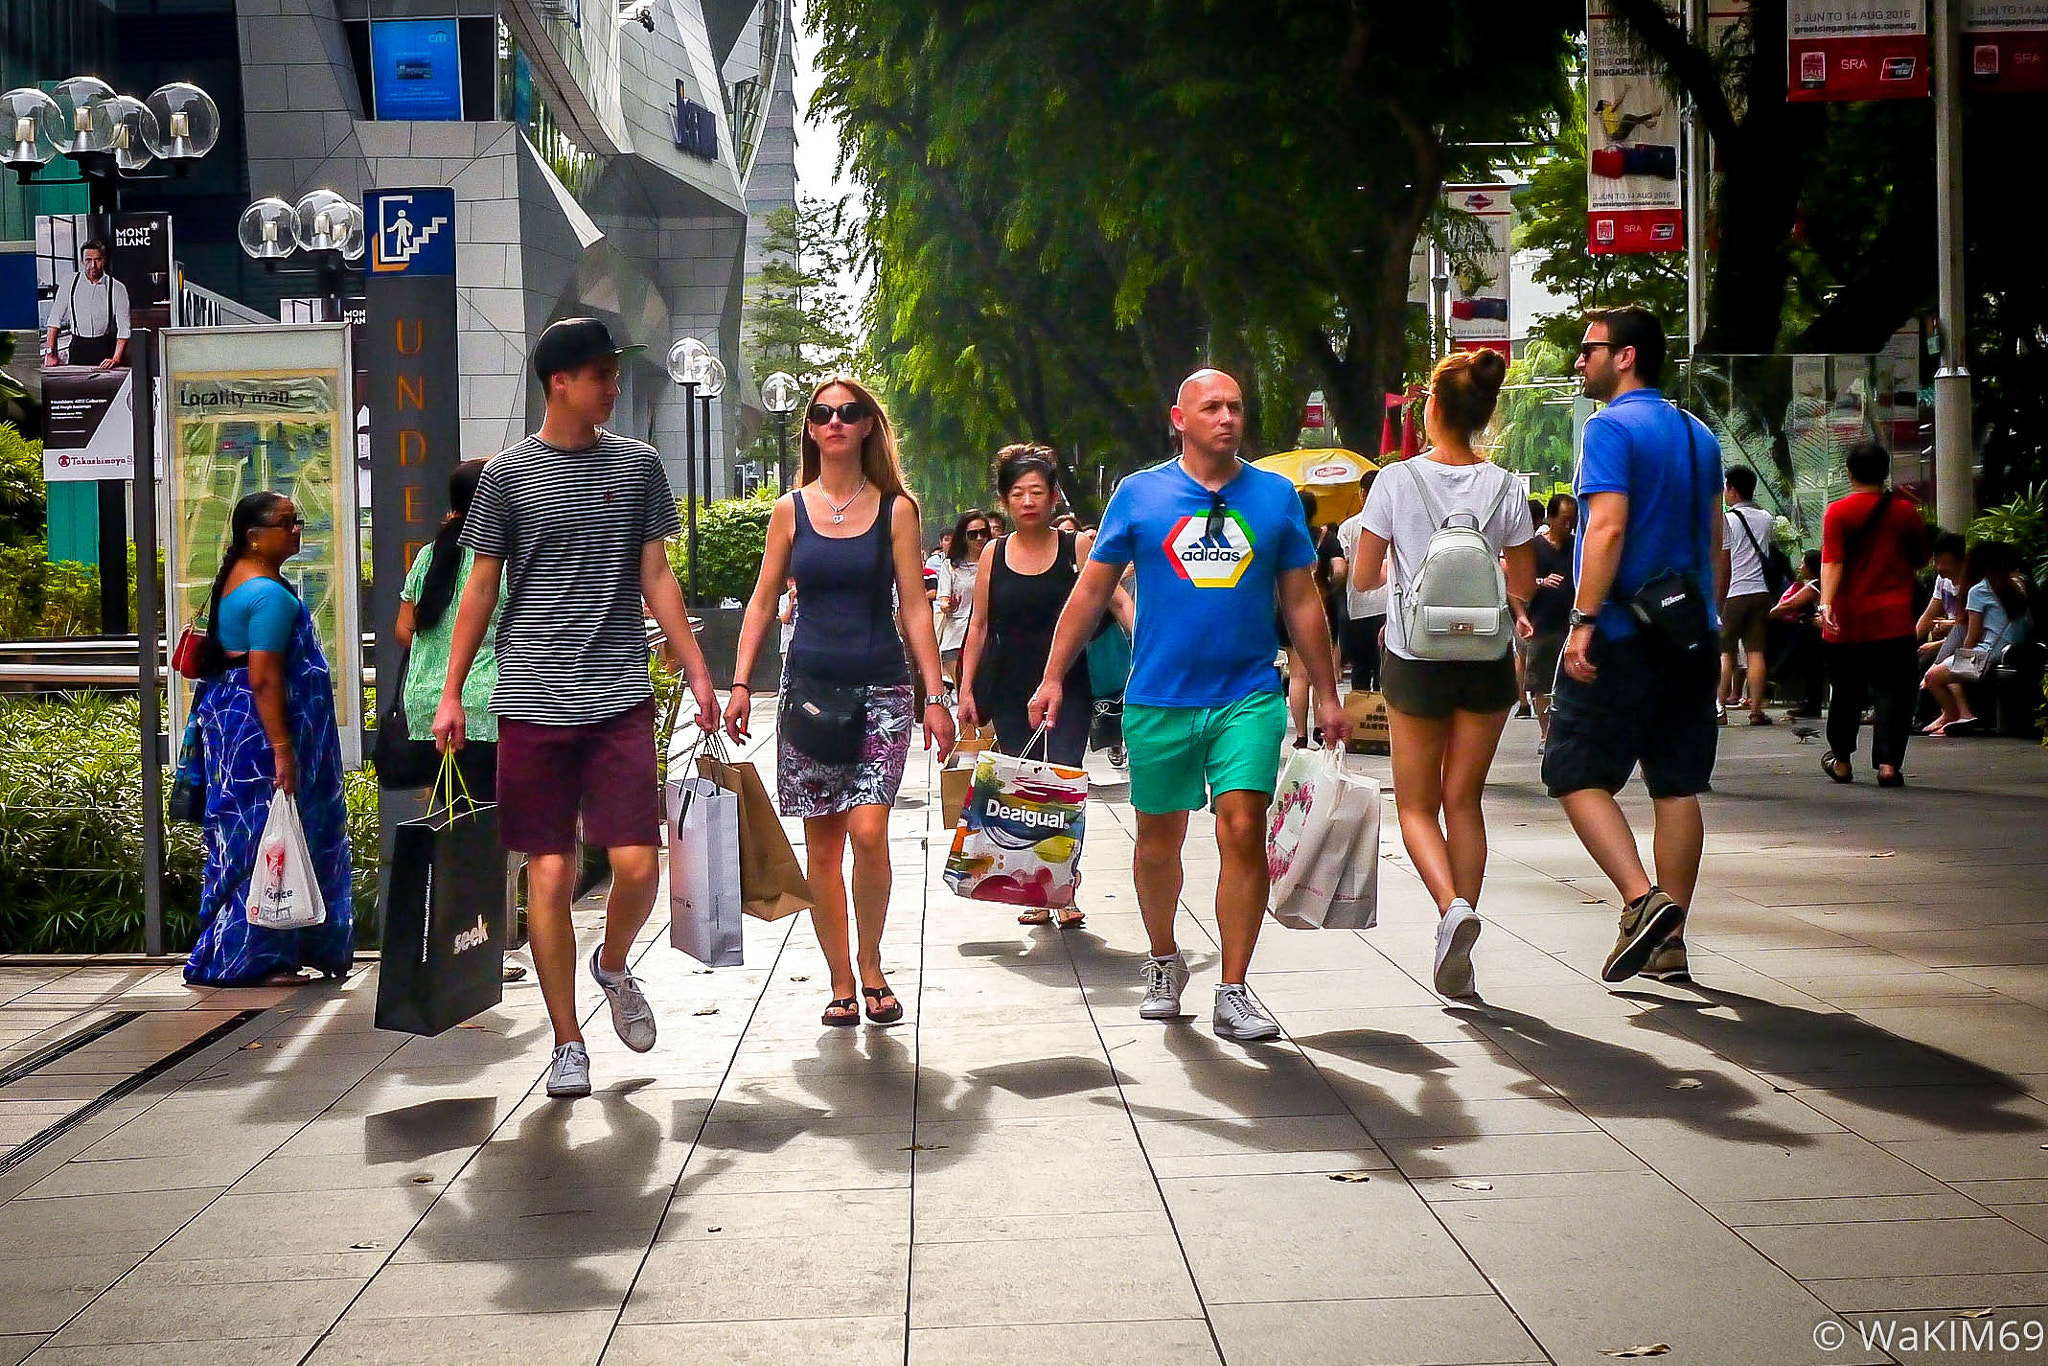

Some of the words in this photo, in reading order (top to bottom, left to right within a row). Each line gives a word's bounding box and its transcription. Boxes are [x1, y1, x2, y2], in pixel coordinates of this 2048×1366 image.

[1804, 12, 1825, 22] JUN
[1828, 11, 1842, 21] TO
[1846, 11, 1857, 20] 14
[1860, 10, 1883, 20] AUG
[1594, 58, 1613, 66] THIS
[2014, 53, 2040, 64] SRA
[1841, 59, 1867, 70] SRA
[1593, 67, 1648, 77] SINGAPORE
[115, 227, 150, 238] MONT
[1623, 224, 1642, 233] SRA
[116, 236, 151, 247] BLANC
[179, 389, 245, 408] Locality
[71, 456, 126, 466] Takashimaya
[1181, 548, 1241, 562] adidas
[985, 798, 1066, 830] Desigual
[453, 913, 489, 955] seek
